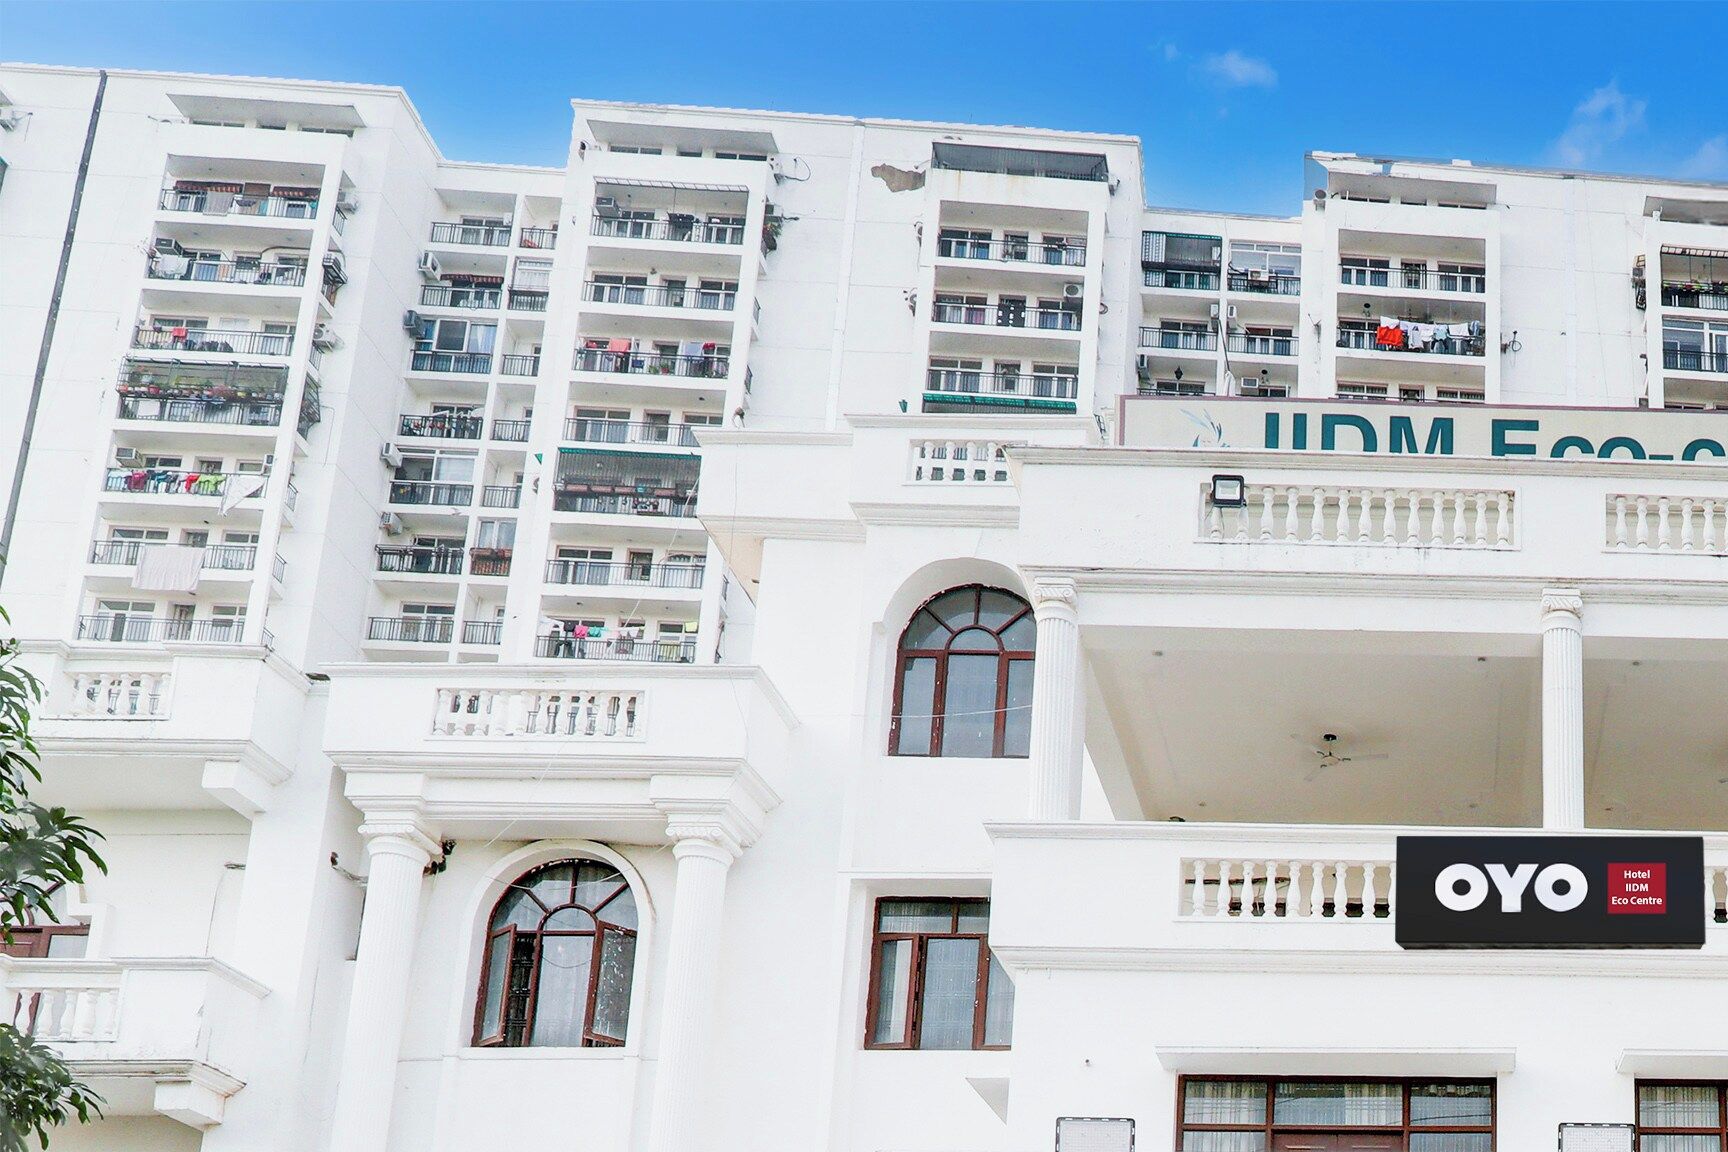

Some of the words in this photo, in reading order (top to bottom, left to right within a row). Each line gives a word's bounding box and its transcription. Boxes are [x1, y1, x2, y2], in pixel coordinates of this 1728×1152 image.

[1265, 412, 1454, 455] IIDM
[1623, 869, 1651, 879] Hotel
[1434, 863, 1589, 913] OYO
[1625, 883, 1649, 892] IIDM
[1611, 896, 1629, 905] Eco
[1630, 896, 1663, 905] Centre
